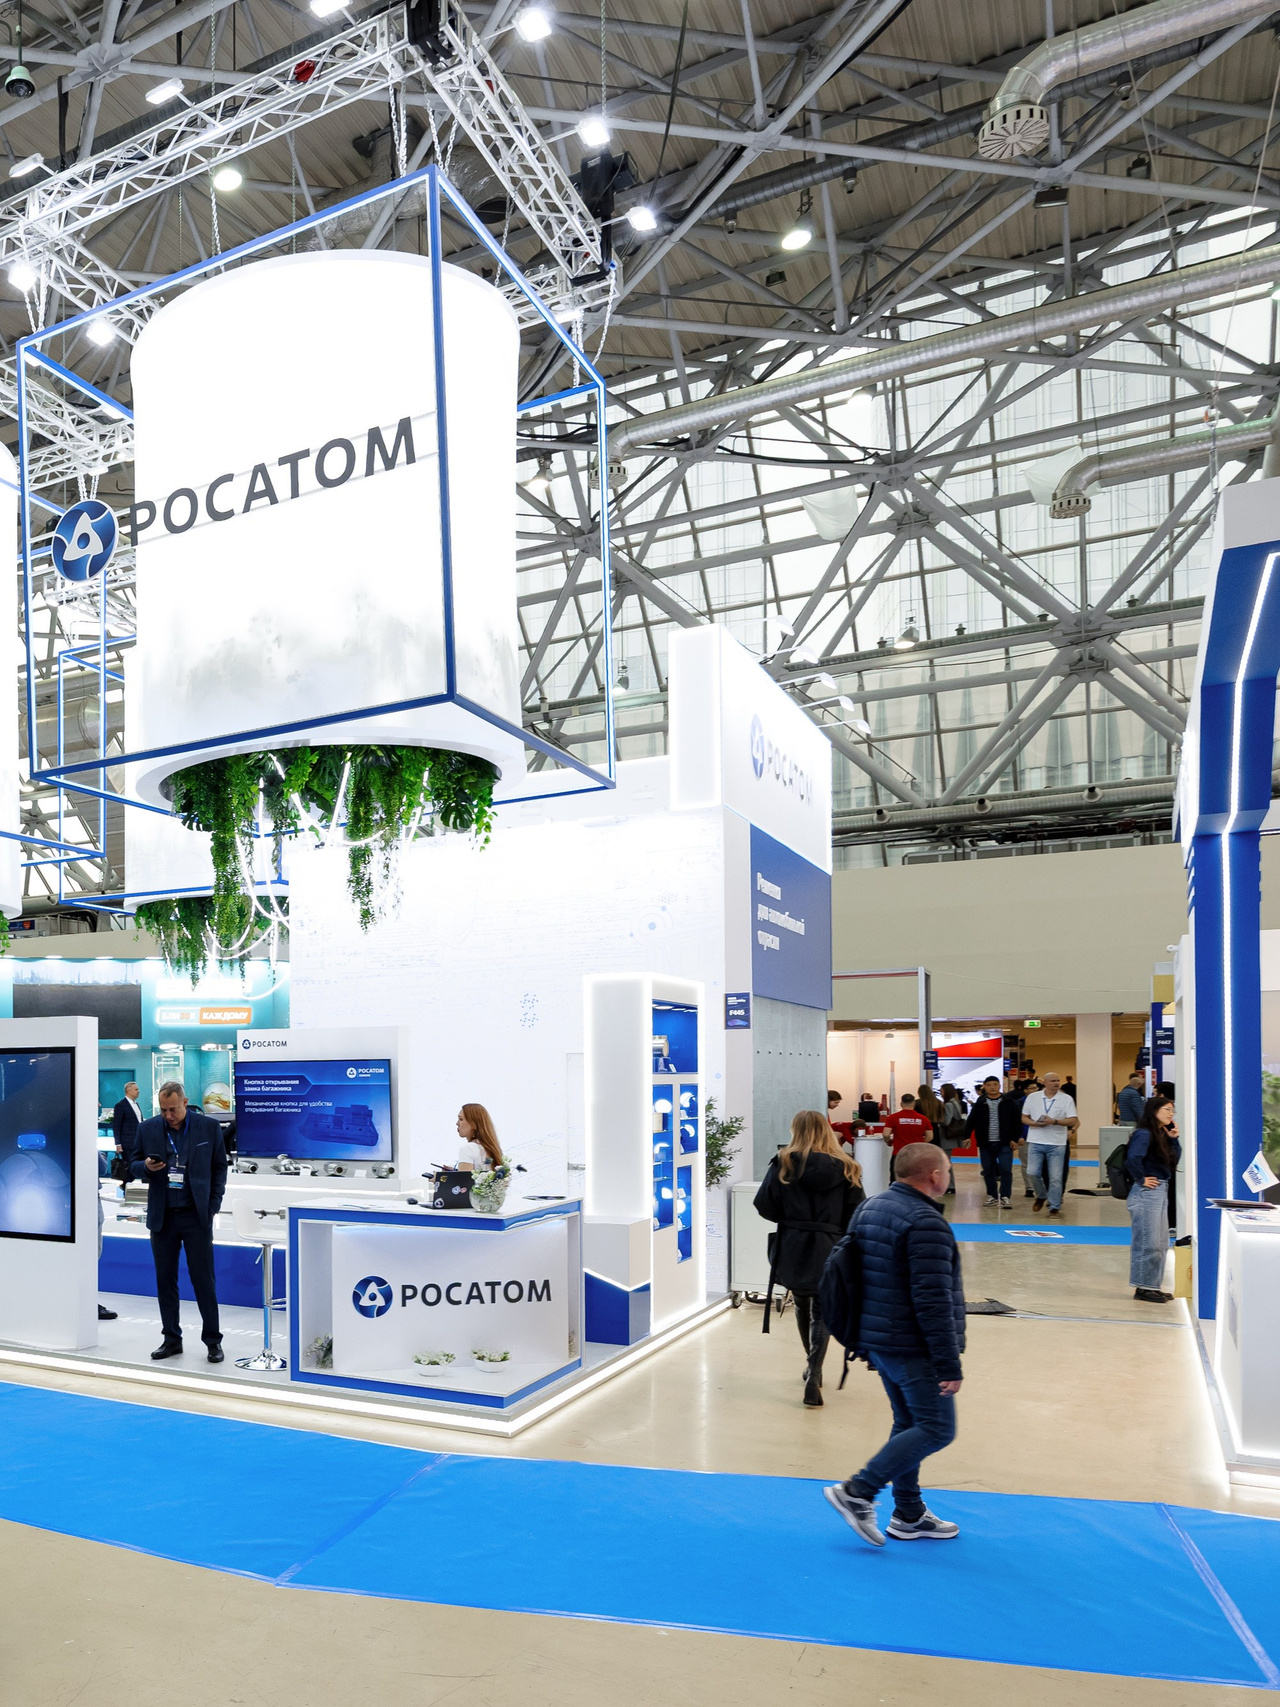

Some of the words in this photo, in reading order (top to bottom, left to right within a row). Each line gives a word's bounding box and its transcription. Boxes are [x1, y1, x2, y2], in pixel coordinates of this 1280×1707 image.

[129, 416, 417, 548] РОСАТОМ
[202, 1011, 249, 1021] КАЖДОМУ
[401, 1279, 552, 1308] РОСАТОМ
